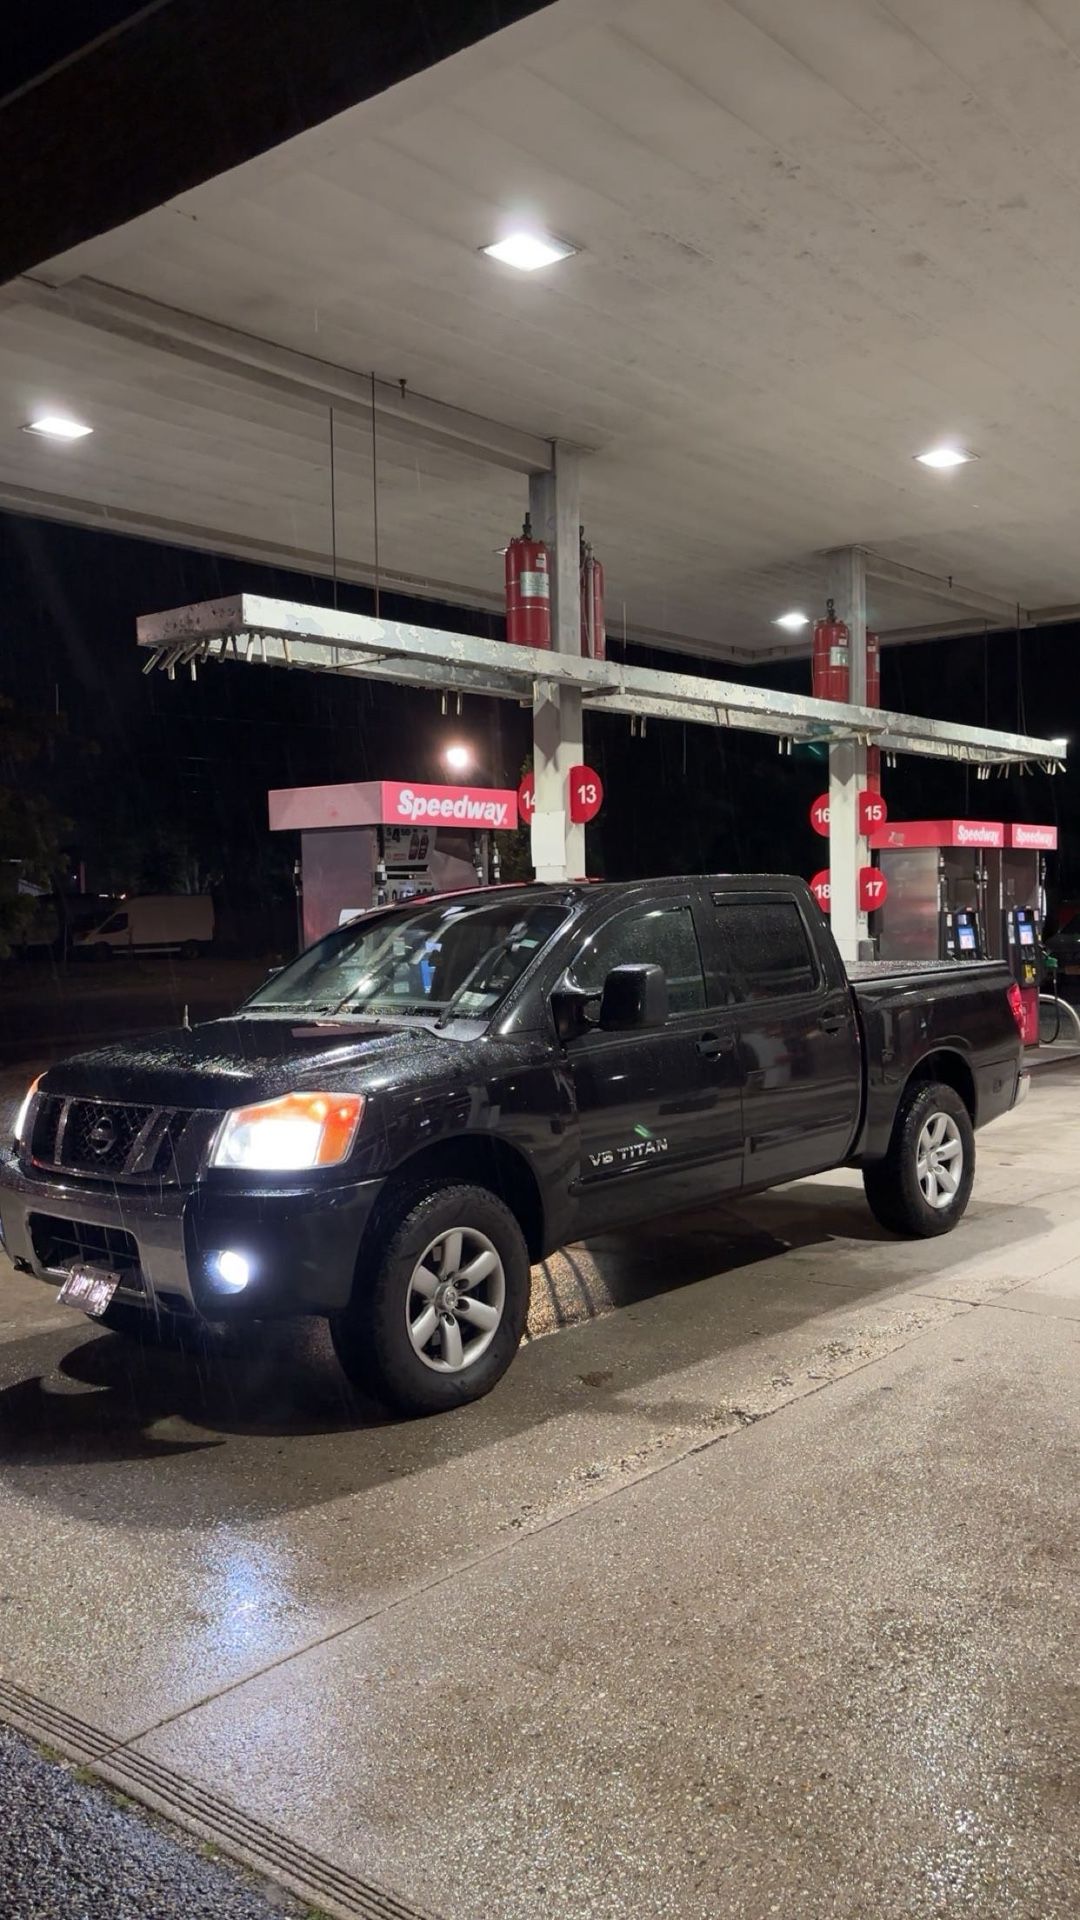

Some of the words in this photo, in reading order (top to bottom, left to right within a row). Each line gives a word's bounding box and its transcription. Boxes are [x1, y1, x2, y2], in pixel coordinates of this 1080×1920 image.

[577, 784, 597, 804] 13
[397, 789, 508, 826] Speedway
[865, 805, 882, 821] 15
[957, 824, 1000, 846] Speedway
[865, 881, 883, 897] 17
[616, 1138, 669, 1160] TITAN
